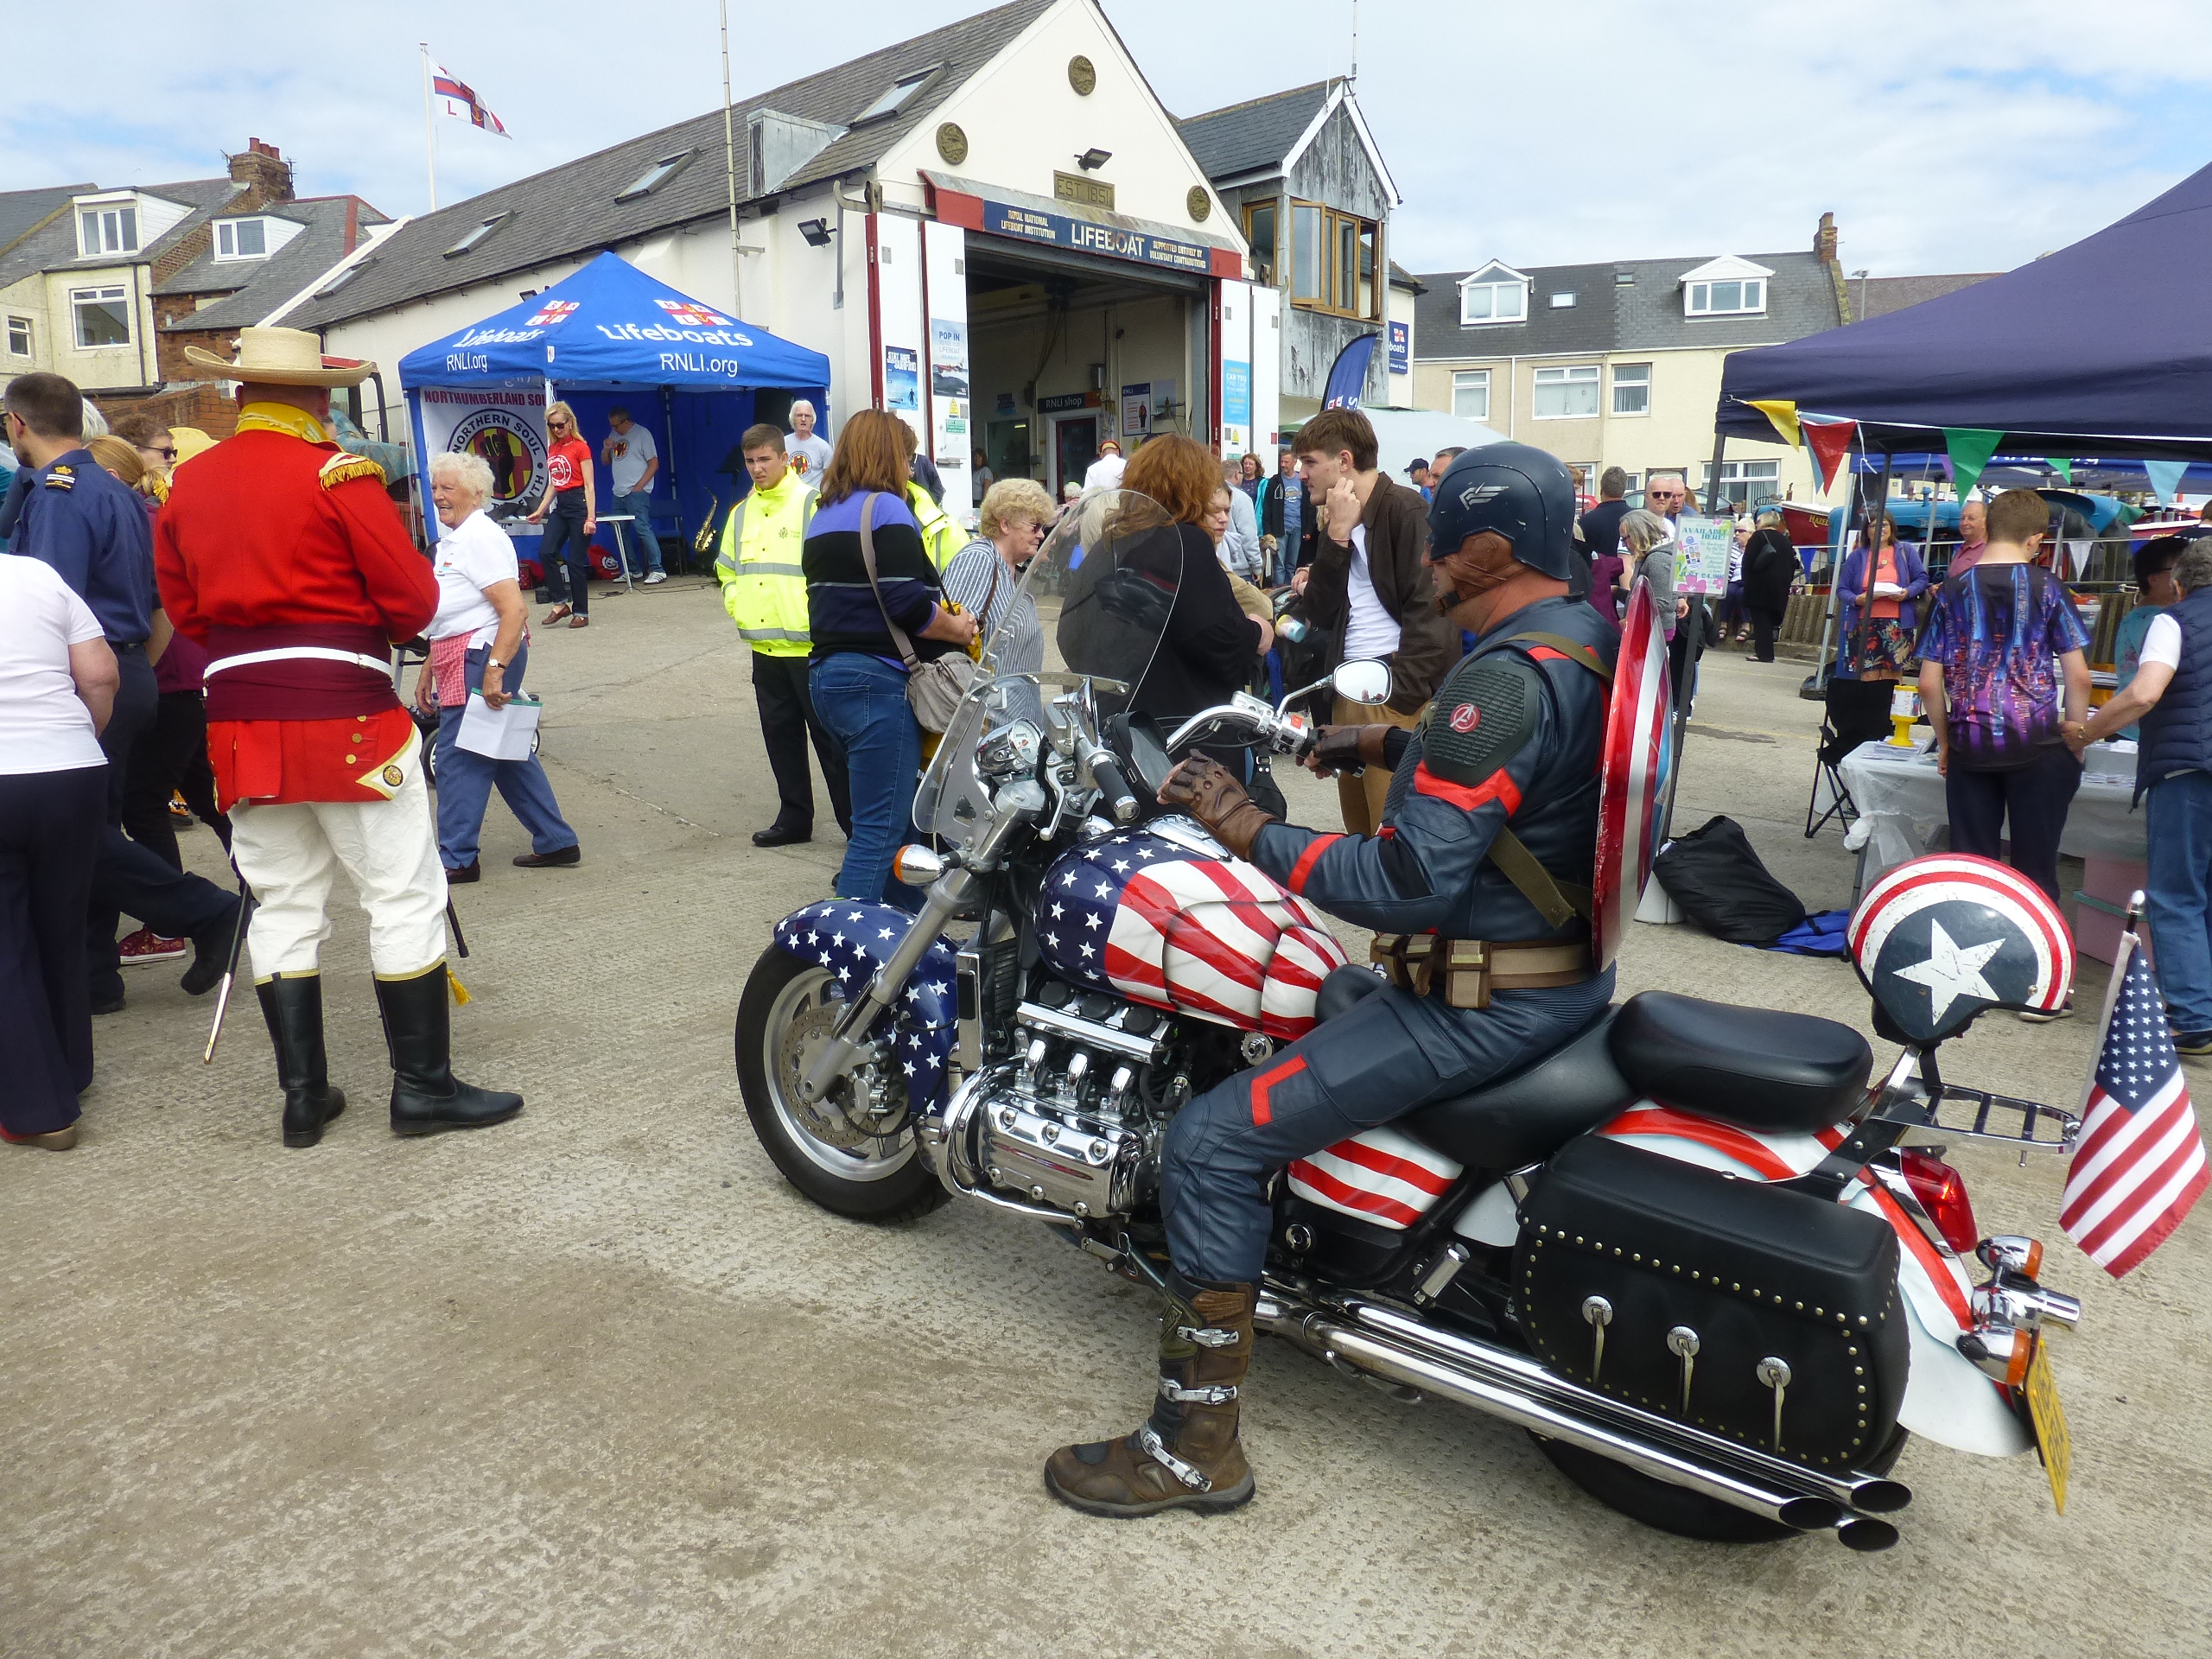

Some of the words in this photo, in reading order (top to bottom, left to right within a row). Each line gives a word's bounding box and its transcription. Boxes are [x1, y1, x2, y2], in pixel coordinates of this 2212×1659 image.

[1057, 178, 1081, 200] EST
[1088, 185, 1109, 206] 1851
[1007, 210, 1024, 222] ROYAL
[1025, 213, 1049, 227] NATIONAL
[1001, 219, 1024, 233] LIFEBOAT
[1025, 225, 1056, 239] INSTITUTION
[1071, 223, 1145, 257] LIFEBOAT
[1153, 240, 1178, 253] SUPPORTED
[1178, 245, 1197, 257] ENTIRELY
[1197, 249, 1203, 258] BY
[1149, 250, 1173, 263] VOLUNTARY
[1173, 254, 1206, 270] CONTRIBUTIONS
[452, 327, 545, 347] Lifeboats
[596, 323, 753, 346] Lifeboats
[938, 331, 952, 340] POP
[953, 333, 960, 341] IN
[938, 346, 960, 354] LIFEBOAT
[446, 353, 487, 372] RNLI.org
[659, 353, 738, 378] RNLI.org
[424, 391, 525, 406] NORTHUMBERLAND
[527, 393, 547, 406] SOU
[1046, 398, 1063, 409] RNLI
[1064, 397, 1082, 408] shop
[451, 413, 511, 454] NORTHERN
[512, 421, 543, 457] SOUL
[1808, 514, 1829, 528] HAZEL
